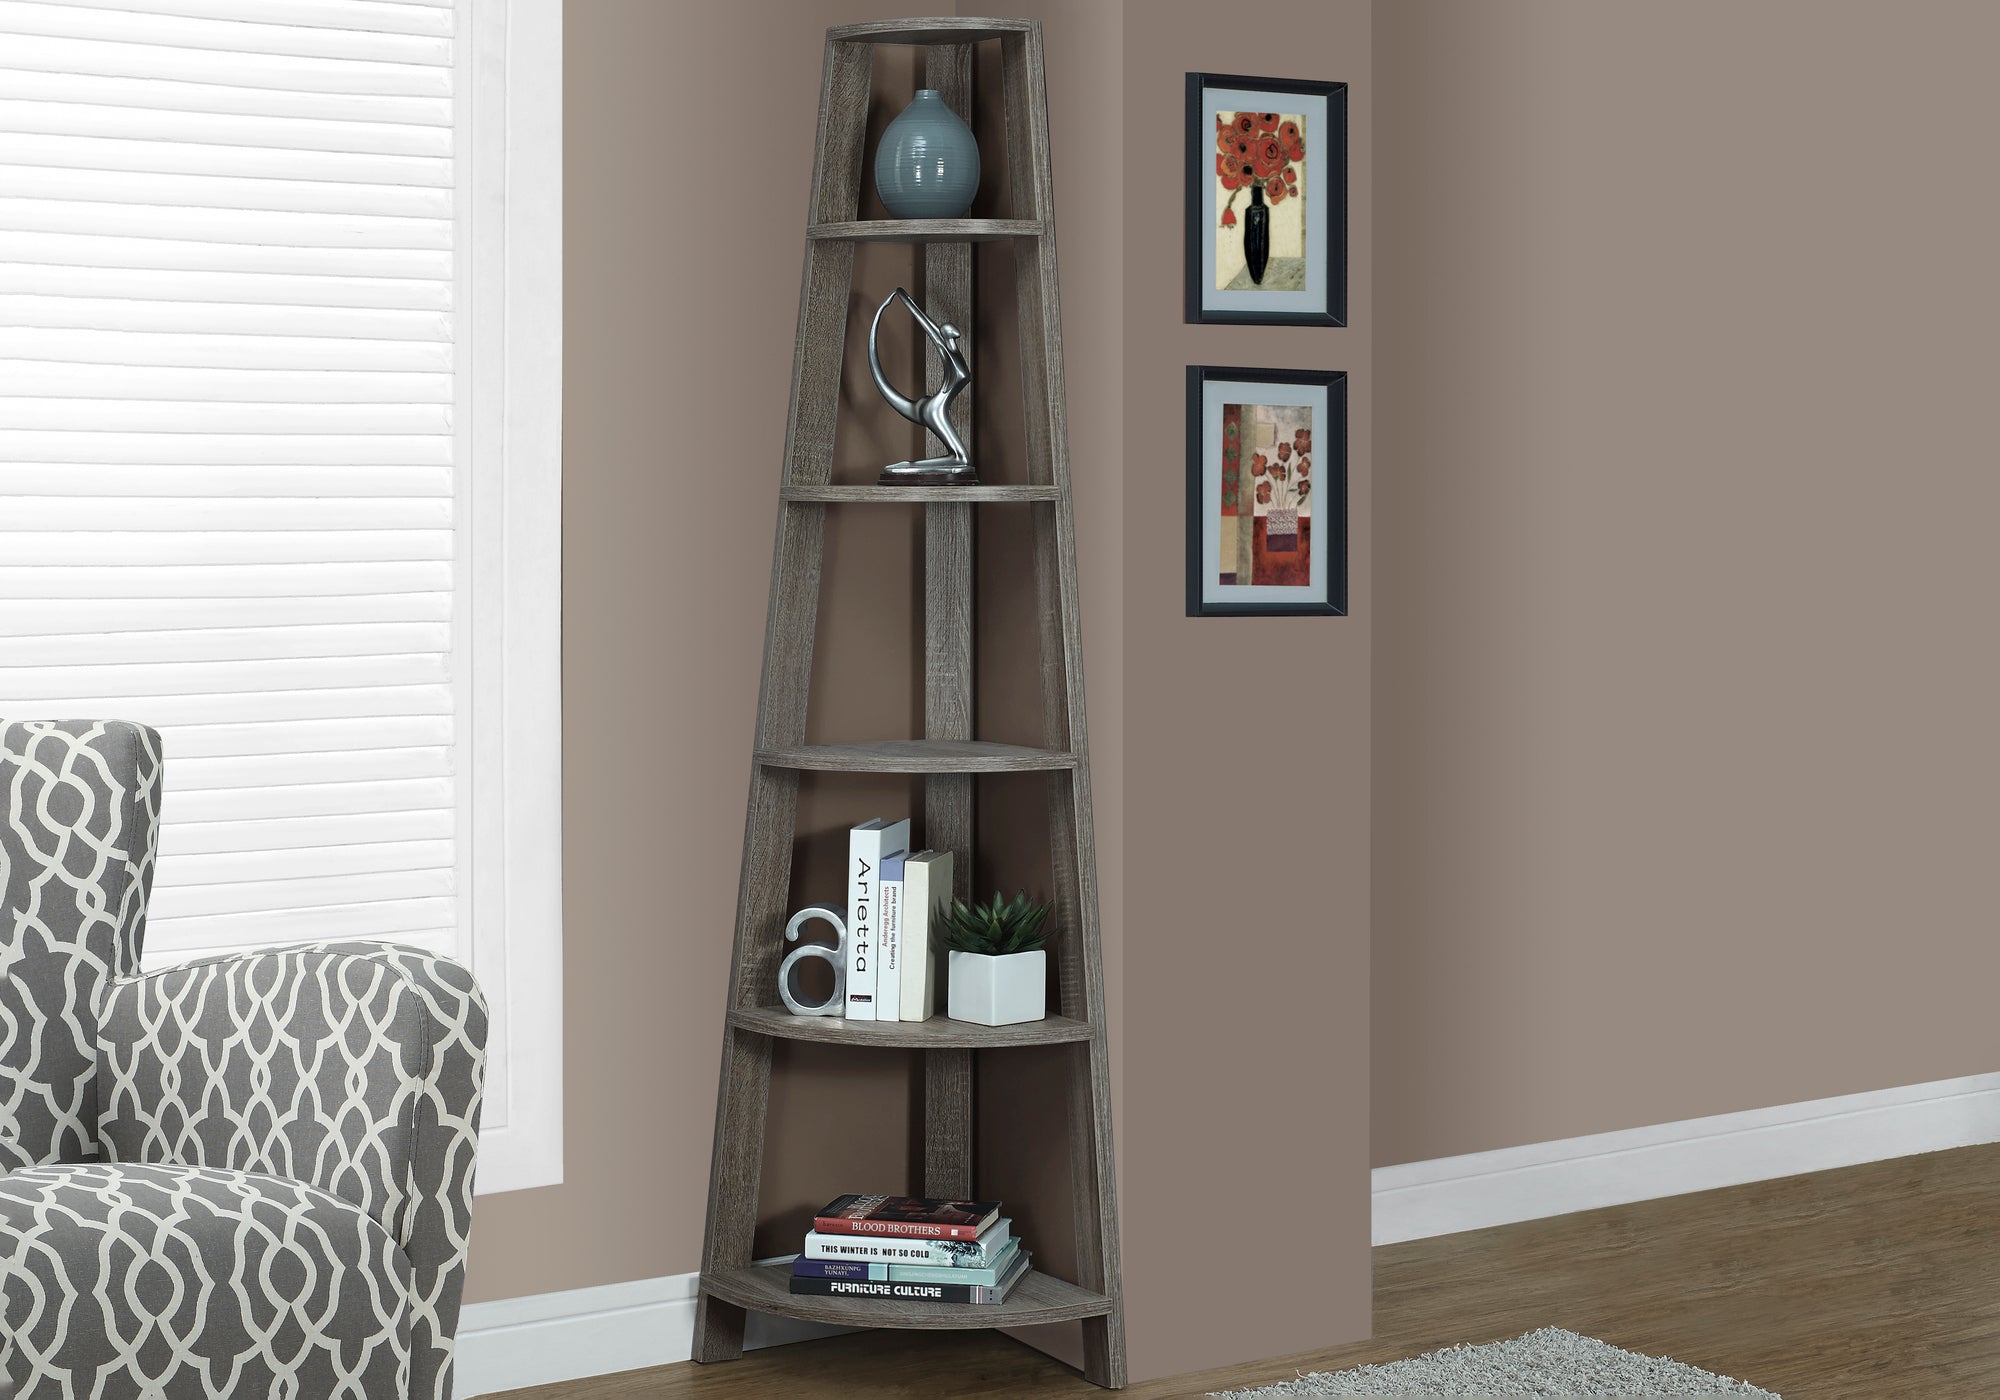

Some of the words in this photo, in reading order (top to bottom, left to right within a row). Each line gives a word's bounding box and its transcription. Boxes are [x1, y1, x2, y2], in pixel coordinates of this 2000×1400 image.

[856, 857, 871, 973] Arletta
[882, 917, 890, 947] Anderegg
[852, 1221, 886, 1233] BLOOD
[887, 1224, 941, 1236] BROTHERS
[821, 1244, 838, 1254] THIS
[840, 1245, 869, 1255] WINTER
[870, 1247, 878, 1256] IS
[882, 1248, 897, 1257] NOT
[898, 1249, 909, 1258] SO
[910, 1250, 930, 1259] COLD
[894, 1286, 942, 1298] CULTURE
